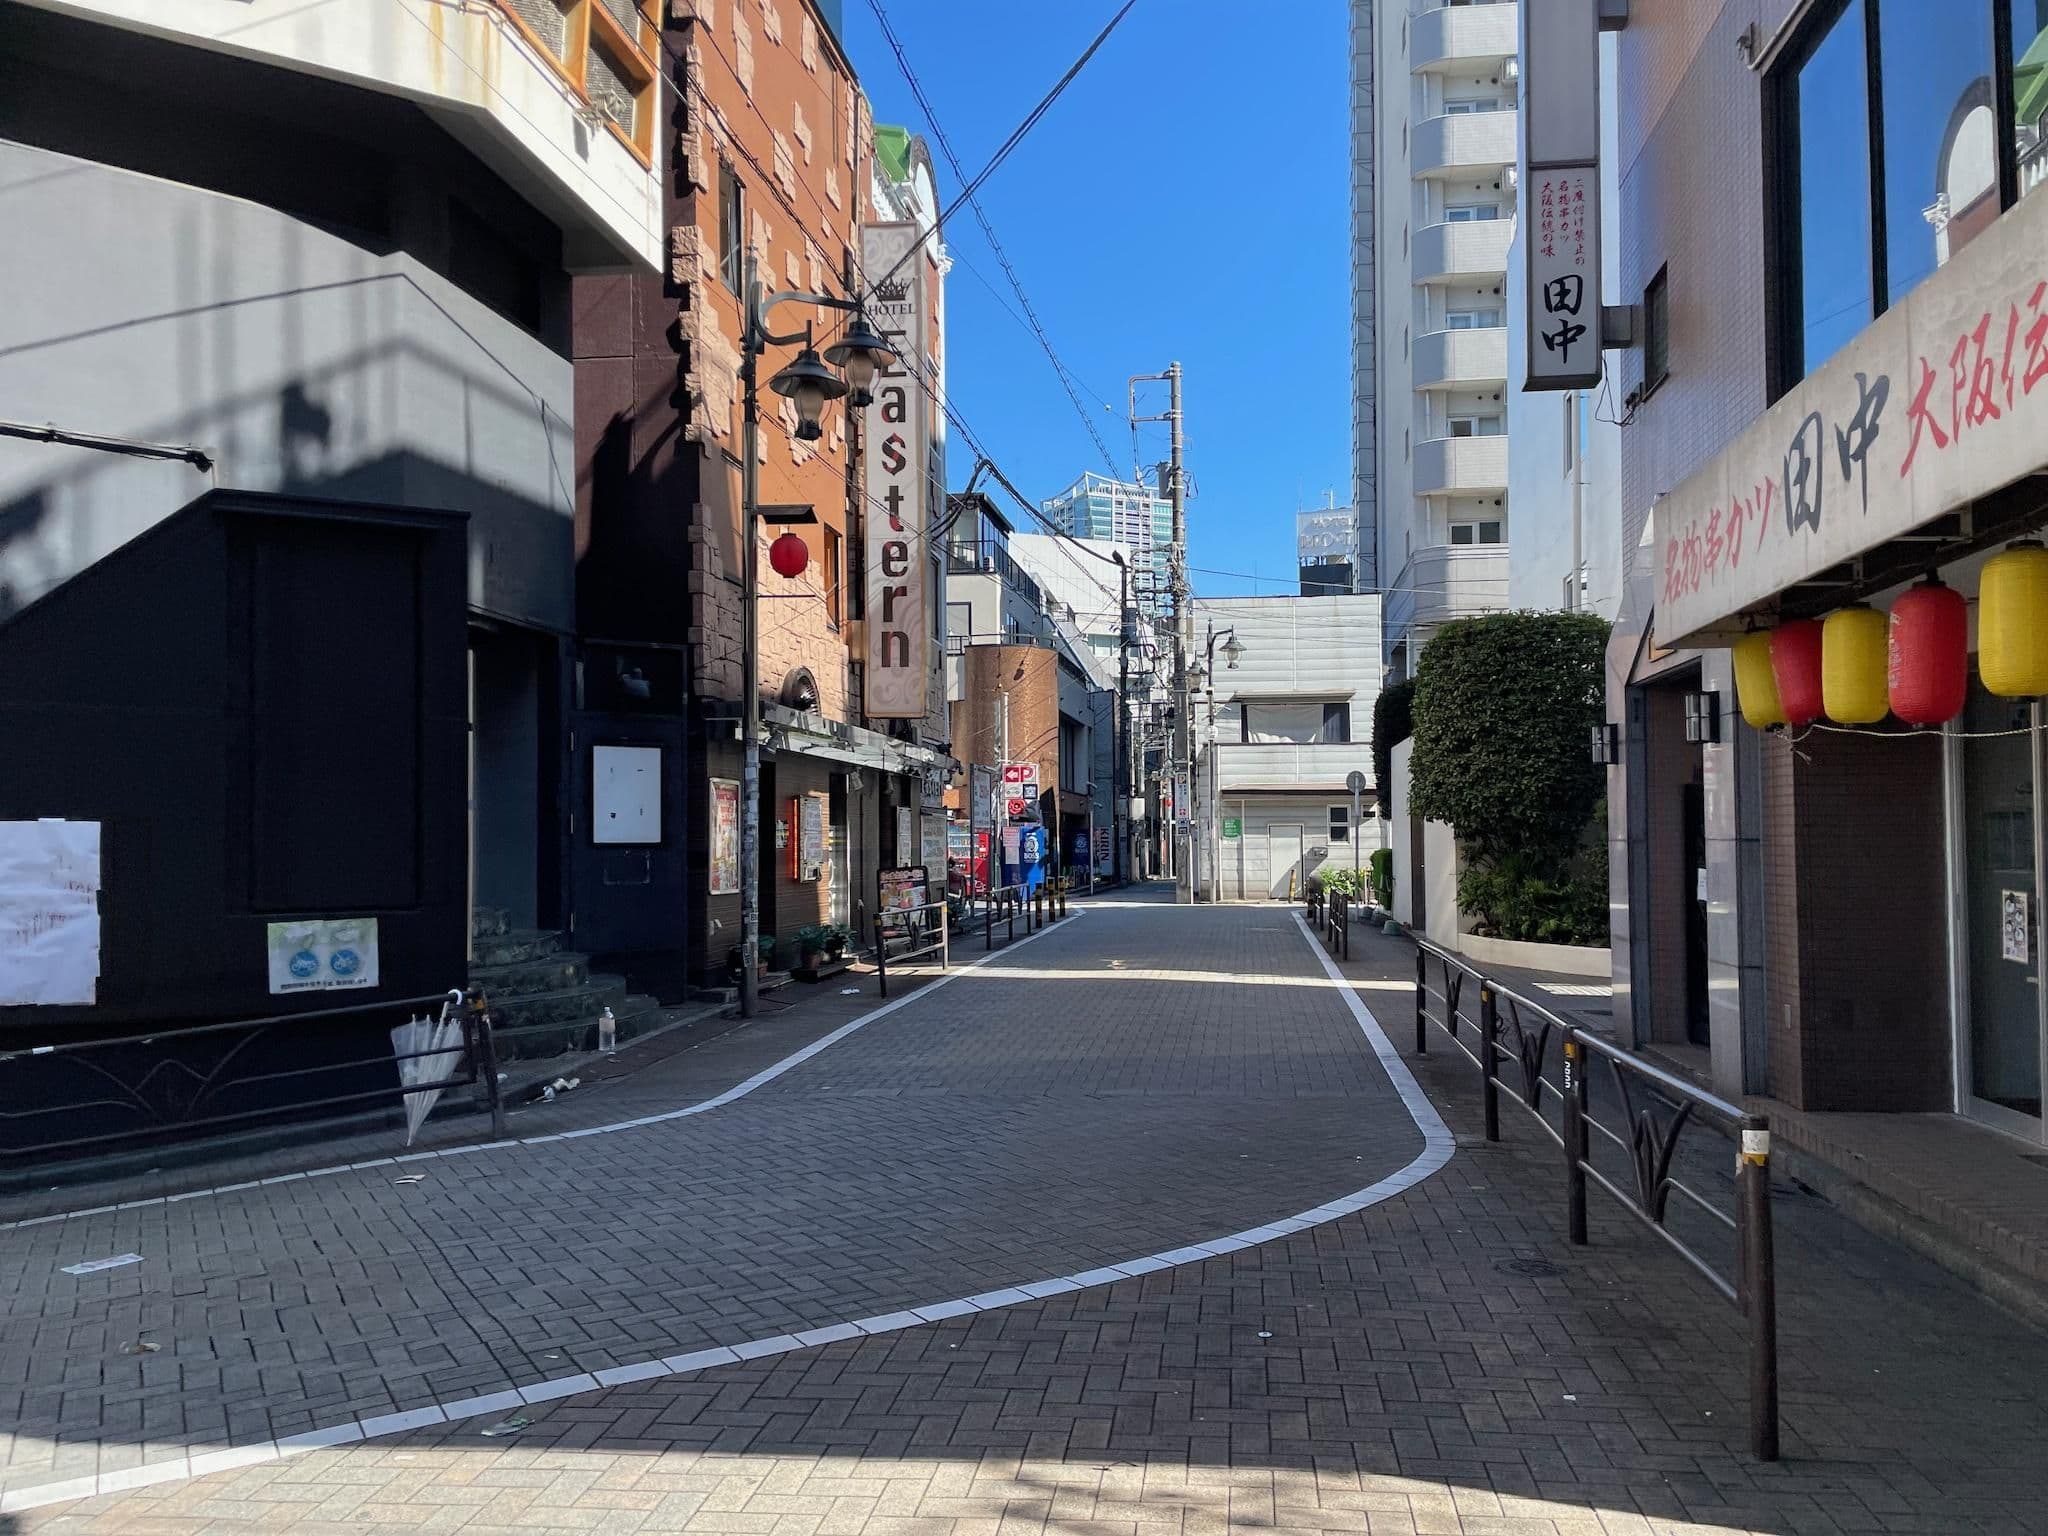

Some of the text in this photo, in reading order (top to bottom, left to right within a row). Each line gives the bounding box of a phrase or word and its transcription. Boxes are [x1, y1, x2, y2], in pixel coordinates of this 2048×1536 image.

[869, 303, 917, 315] HOTEL
[1541, 274, 1587, 364] 田中
[1663, 476, 1778, 605] 名物串カツ
[1783, 371, 1890, 537] 田中
[1100, 828, 1109, 860] KIRIN
